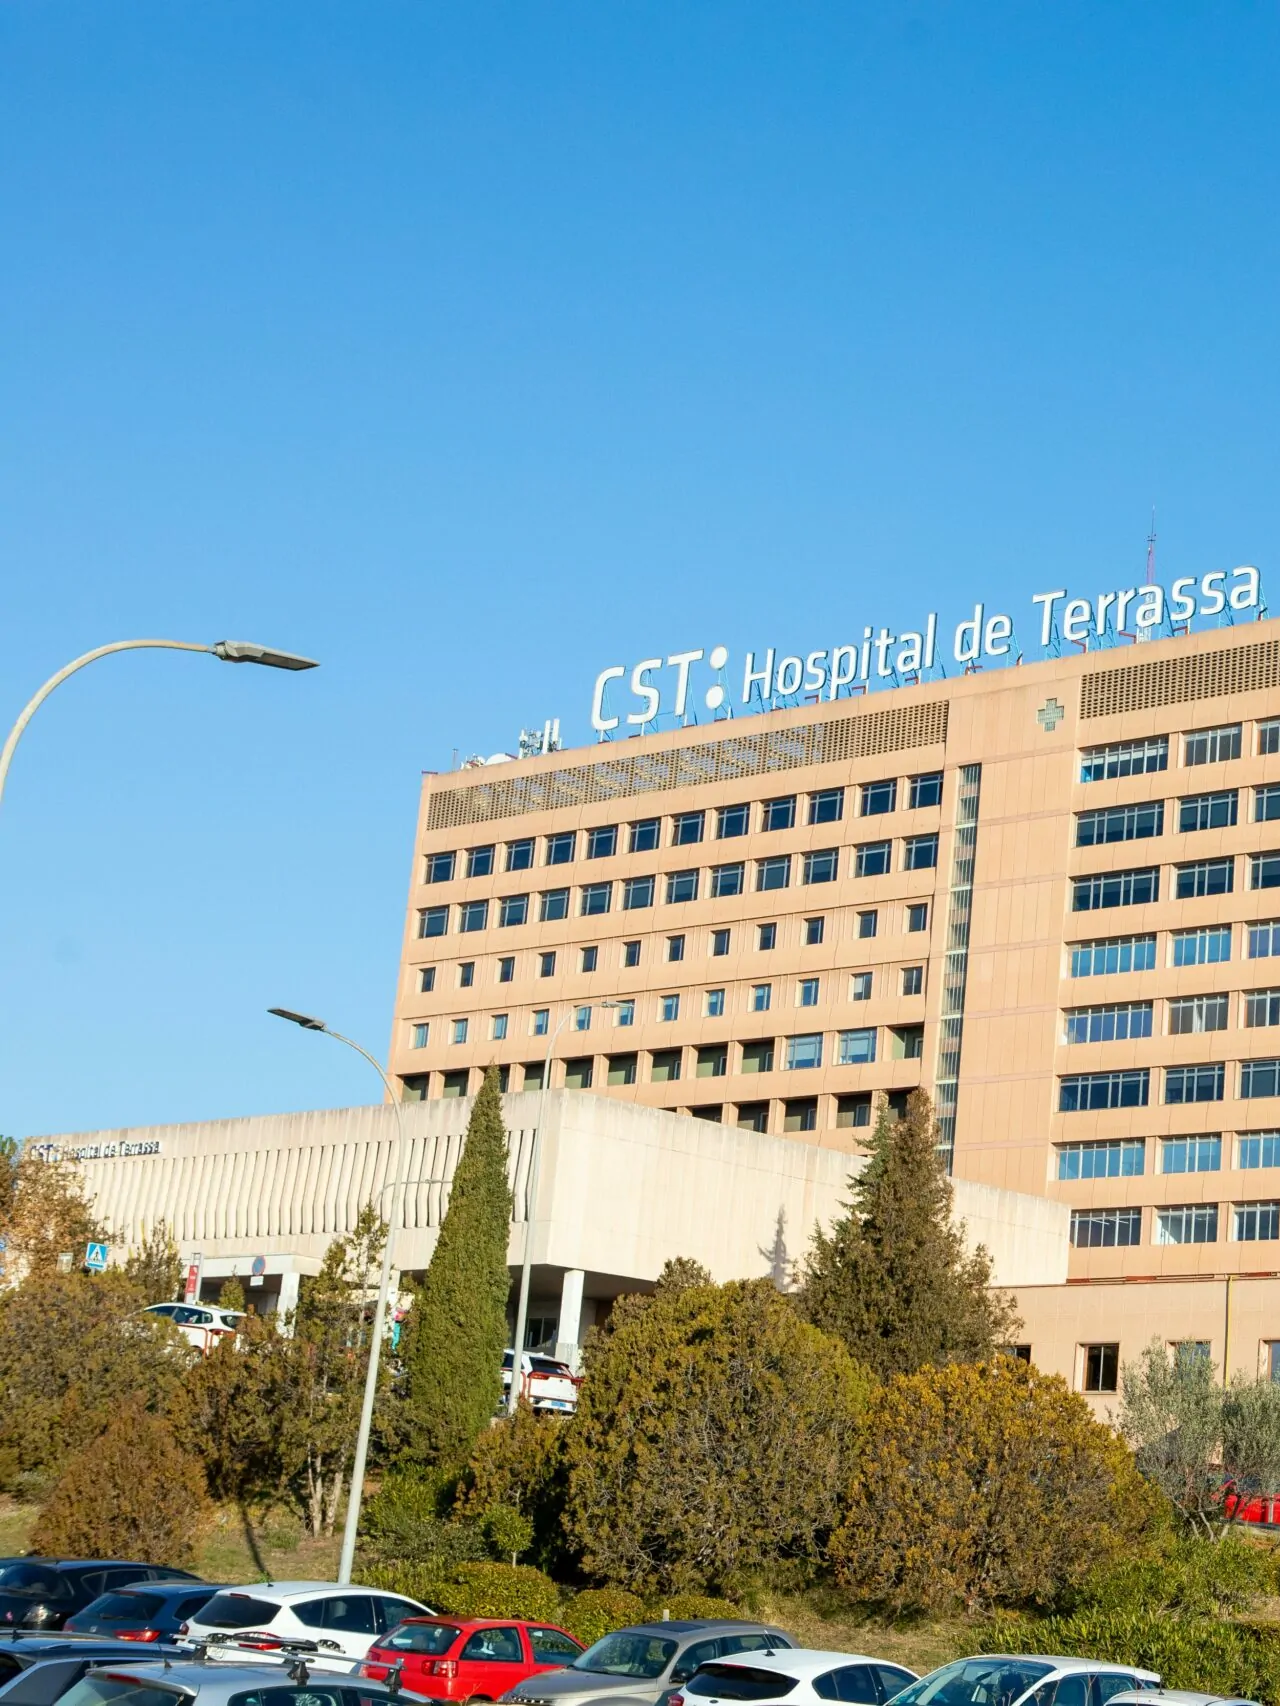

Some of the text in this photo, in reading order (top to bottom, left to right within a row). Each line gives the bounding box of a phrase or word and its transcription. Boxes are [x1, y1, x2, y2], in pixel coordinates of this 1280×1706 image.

[742, 612, 937, 704] Hospital
[953, 603, 1012, 662] de
[1032, 564, 1261, 647] Terrassa
[119, 1140, 161, 1157] Terrassa
